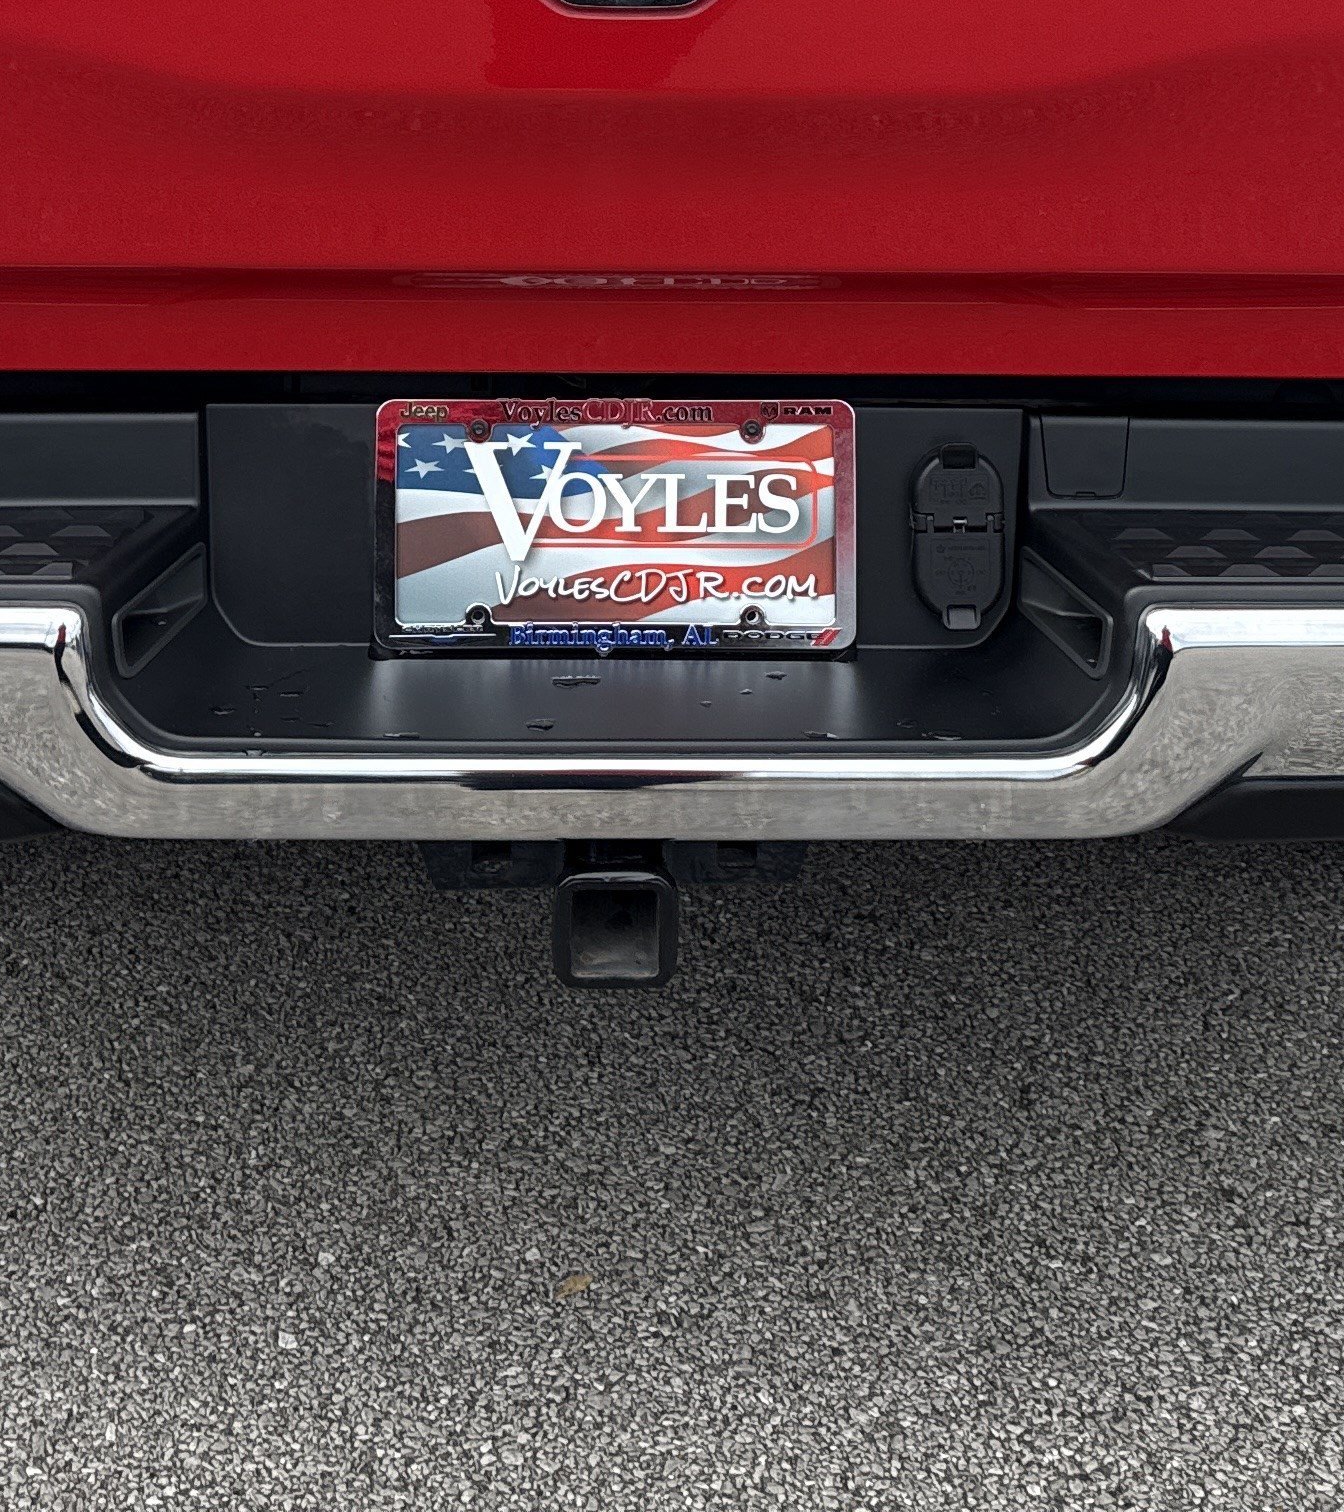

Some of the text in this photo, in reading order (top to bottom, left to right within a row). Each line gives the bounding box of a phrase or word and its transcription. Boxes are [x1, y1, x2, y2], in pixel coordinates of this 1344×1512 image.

[400, 401, 450, 422] Jeep
[498, 398, 714, 429] VoylesCDJR.com
[782, 405, 834, 416] RAM
[463, 441, 801, 562] VOYLES
[509, 621, 720, 655] Birmingham, AL
[722, 629, 821, 640] DODGE
